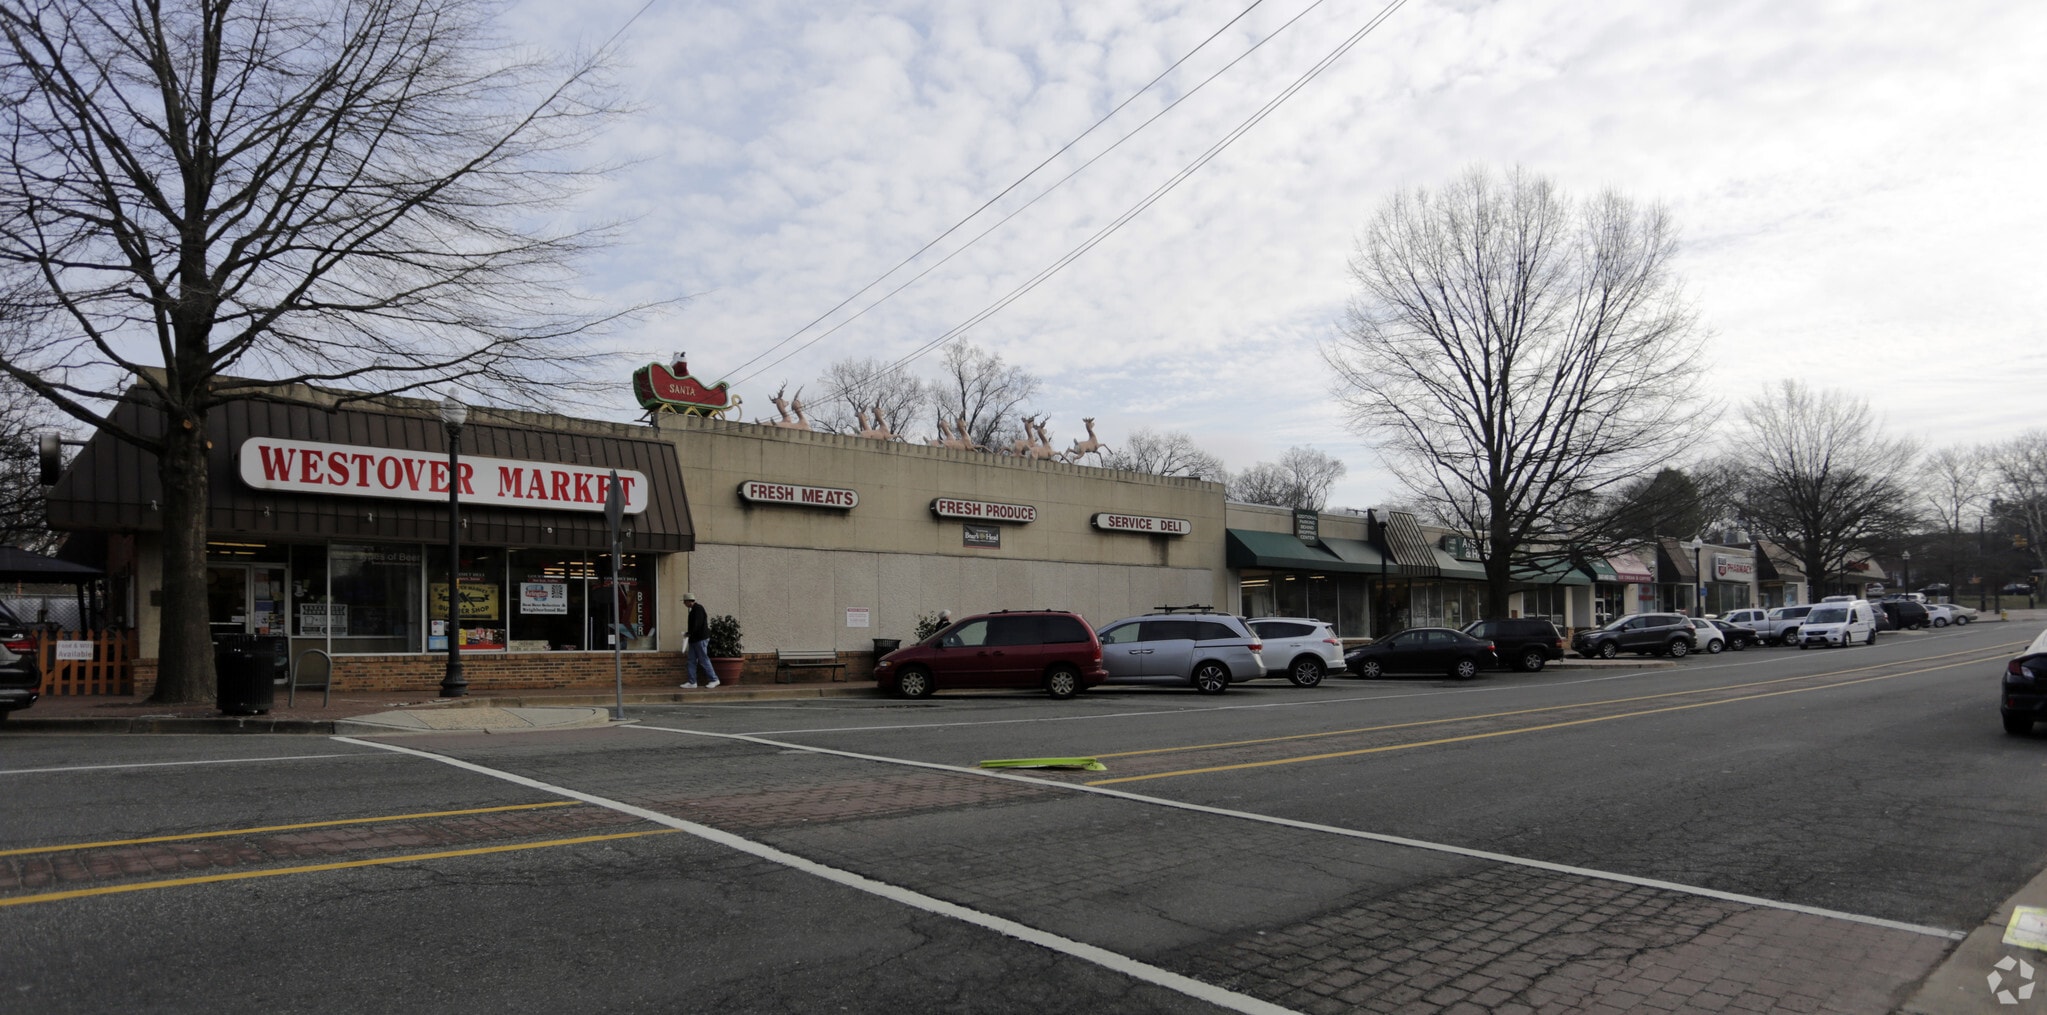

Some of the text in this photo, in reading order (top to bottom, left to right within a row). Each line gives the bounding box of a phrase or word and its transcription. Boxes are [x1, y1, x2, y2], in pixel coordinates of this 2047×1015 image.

[669, 384, 696, 396] SANTA
[258, 445, 636, 506] WESTOVER MARKET
[750, 484, 854, 506] FRESH MEATS
[939, 500, 1034, 520] FRESH PRODUCE
[1108, 515, 1182, 532] SERVICE DELI
[985, 532, 999, 541] Head
[471, 605, 490, 613] SHOP
[637, 591, 645, 636] BEER
[58, 650, 92, 658] Available
